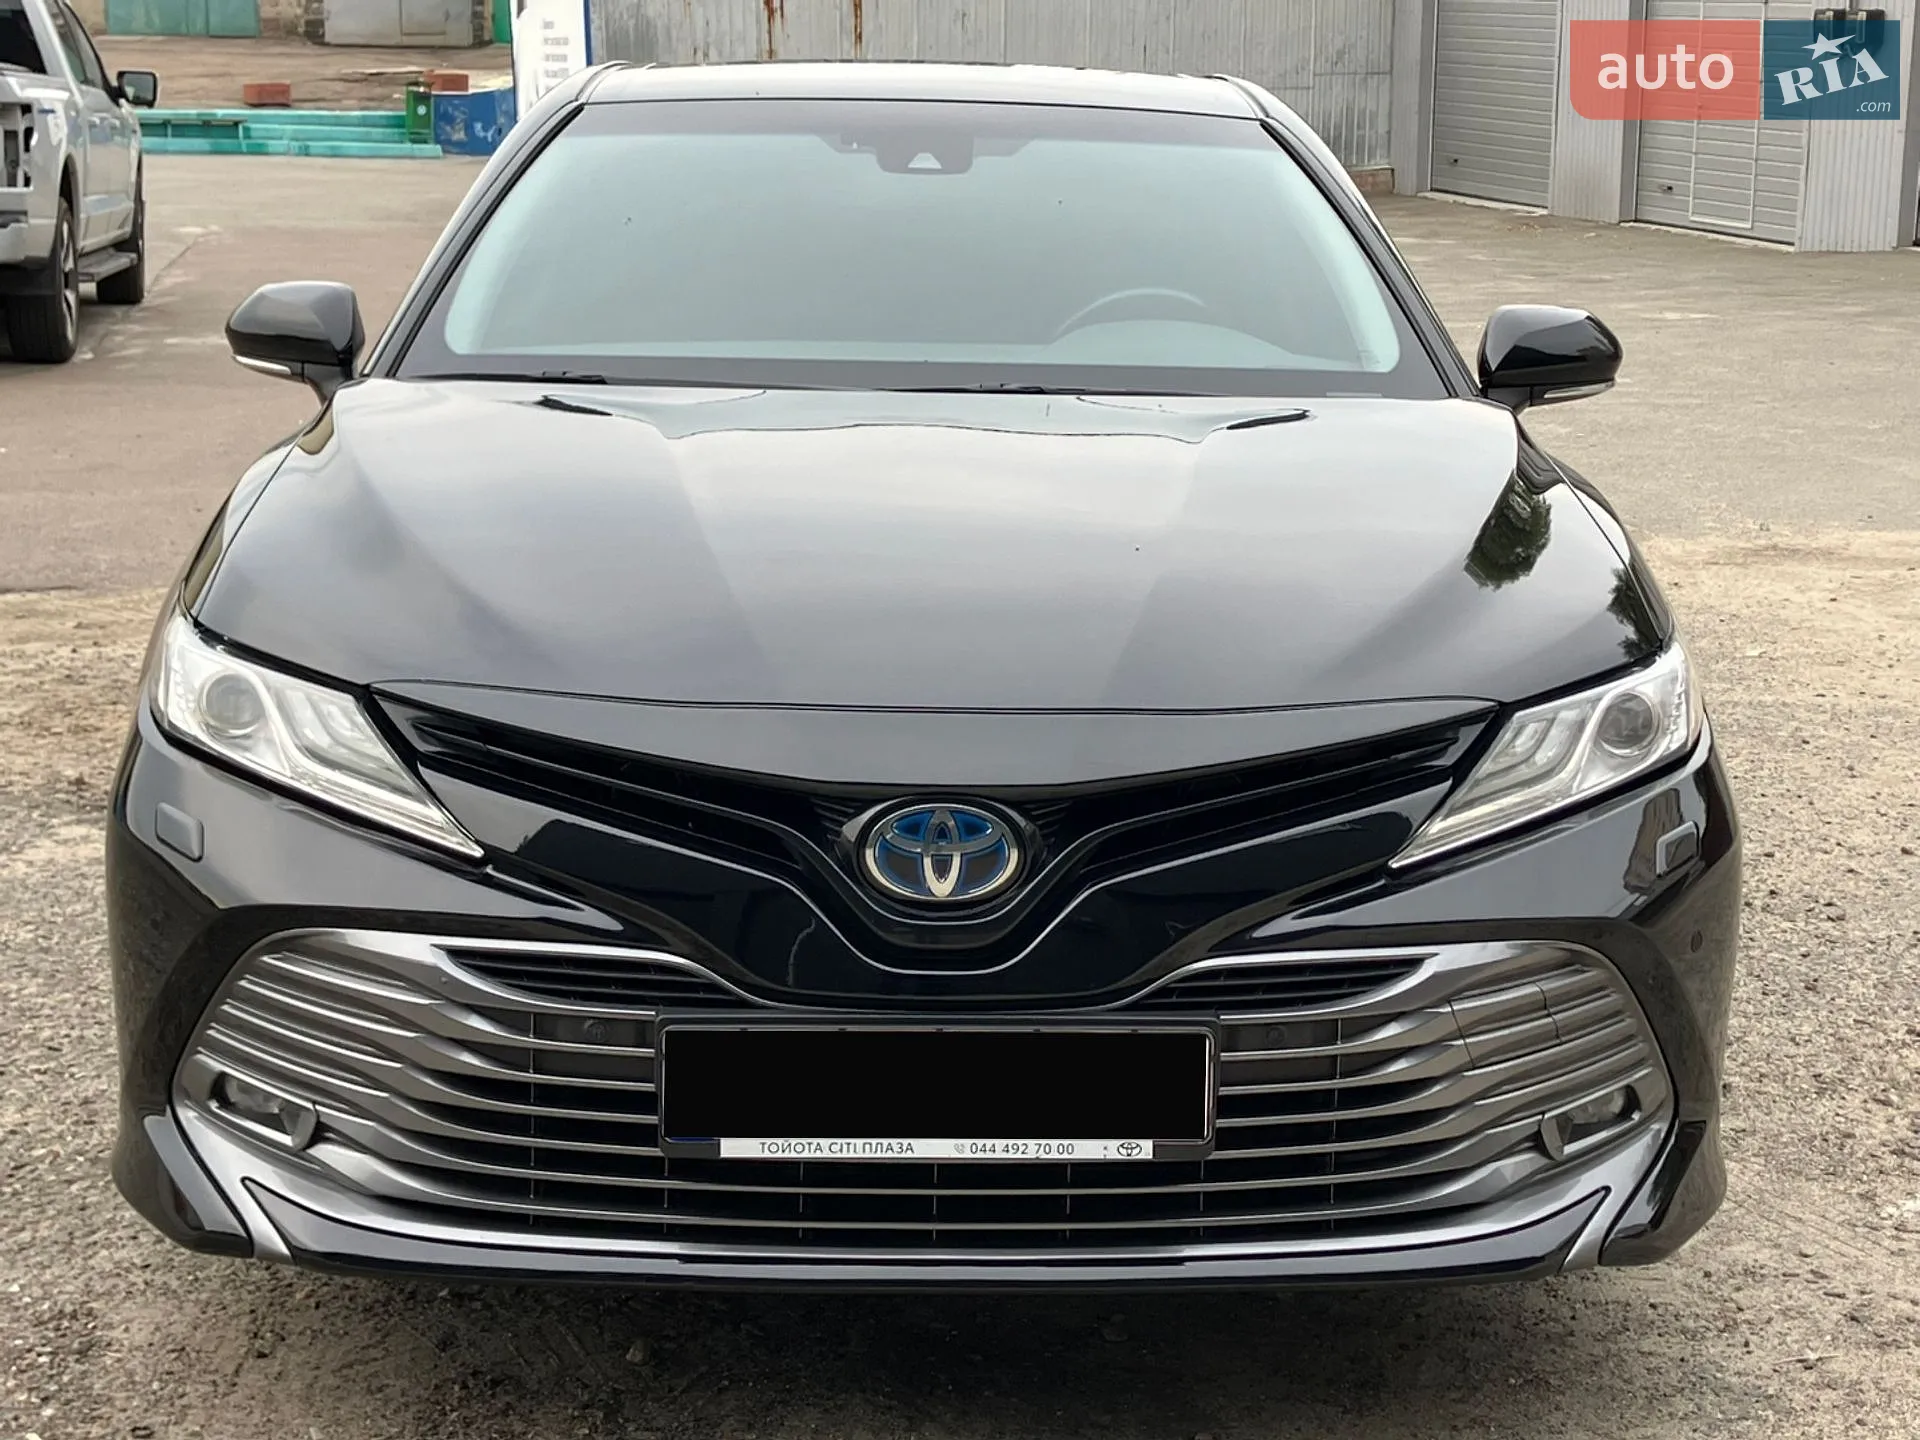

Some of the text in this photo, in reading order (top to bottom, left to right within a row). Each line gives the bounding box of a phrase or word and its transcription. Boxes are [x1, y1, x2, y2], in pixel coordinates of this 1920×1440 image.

[759, 1139, 823, 1154] ТОЙОТА
[862, 1141, 915, 1154] ПЛАЗА
[970, 1142, 996, 1155] 044
[1001, 1142, 1029, 1155] 492
[1034, 1142, 1052, 1155] 70
[1056, 1142, 1075, 1155] 00
